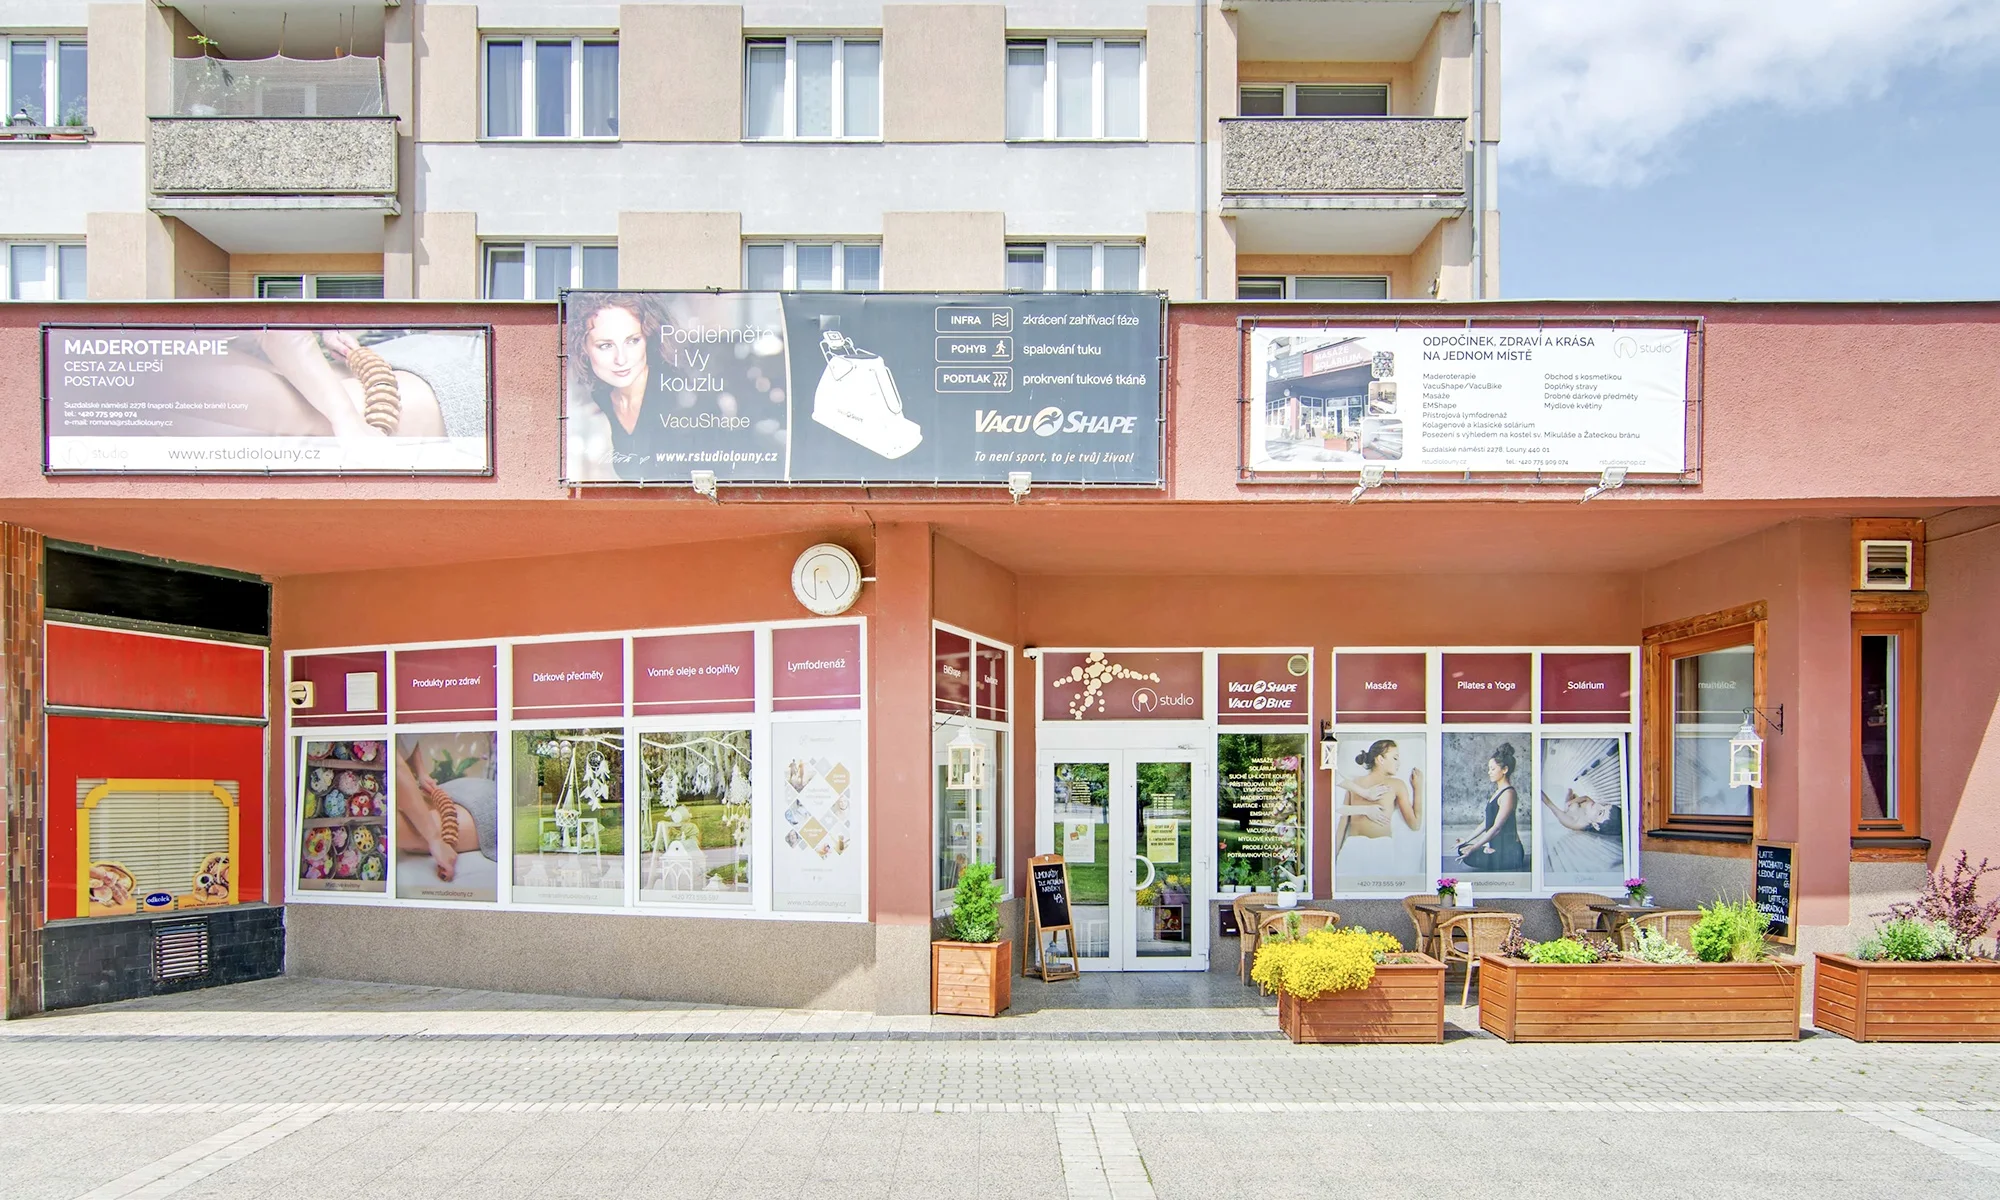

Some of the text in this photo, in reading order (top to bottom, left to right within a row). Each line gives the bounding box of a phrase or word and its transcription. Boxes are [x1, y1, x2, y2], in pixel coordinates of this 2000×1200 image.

[950, 315, 982, 325] INFRA
[1022, 314, 1139, 326] zkrácení zahřívací fáze
[660, 324, 775, 344] Podlehněte
[1423, 334, 1595, 348] ODPOČINEK, ZDRAVÍ A KRÁSA
[64, 339, 229, 355] MADEROTERAPIE
[951, 344, 987, 354] POHYB
[1023, 344, 1101, 356] spalování tuku
[1640, 342, 1672, 354] studio
[674, 349, 710, 372] i Vy
[1423, 349, 1532, 361] NA JEDNOM MÍSTĚ
[64, 359, 163, 373] CESTA ZA LEPŠÍ
[64, 376, 135, 387] POSTAVOU
[660, 373, 723, 392] kouzlu
[943, 374, 991, 383] PODTLAK
[1022, 373, 1147, 386] prokrvení tukové tkáně
[1423, 373, 1476, 381] Maderoterapie
[1423, 382, 1502, 391] VacuShape/VacuBike
[1544, 383, 1574, 391] Doplňky
[1544, 392, 1638, 401] Drobné dárkové předměty
[129, 402, 146, 410] 2278
[227, 403, 248, 411] Louny
[1423, 402, 1457, 410] EMShape
[1544, 402, 1602, 410] Mýdlové květiny
[659, 412, 751, 431] VacuShape
[1422, 412, 1507, 420] Přístrojová lymfodrenáž
[975, 410, 1138, 434] VACU SHAPE
[1422, 421, 1465, 429] Kolagenové
[1461, 431, 1497, 439] výhledem
[168, 447, 321, 463] www.rstudiolouny.cz
[656, 451, 778, 464] www.rstudiolouny.cz
[974, 451, 1134, 465] To není sport, to je tvůj život!
[648, 664, 740, 677] Vonné oleje a doplňky
[787, 658, 846, 672] Lymfodrenáž
[412, 676, 481, 688] Produkty pro zdraví
[532, 671, 604, 682] Dárkové předměty
[1228, 682, 1298, 693] VACU SHAPE
[1365, 681, 1398, 690] Masáže
[1457, 681, 1486, 690] Pilates
[1494, 681, 1516, 691] Yoga
[1567, 681, 1604, 690] Solárium
[1159, 693, 1194, 706] studio
[1228, 698, 1293, 708] VACU BIKE
